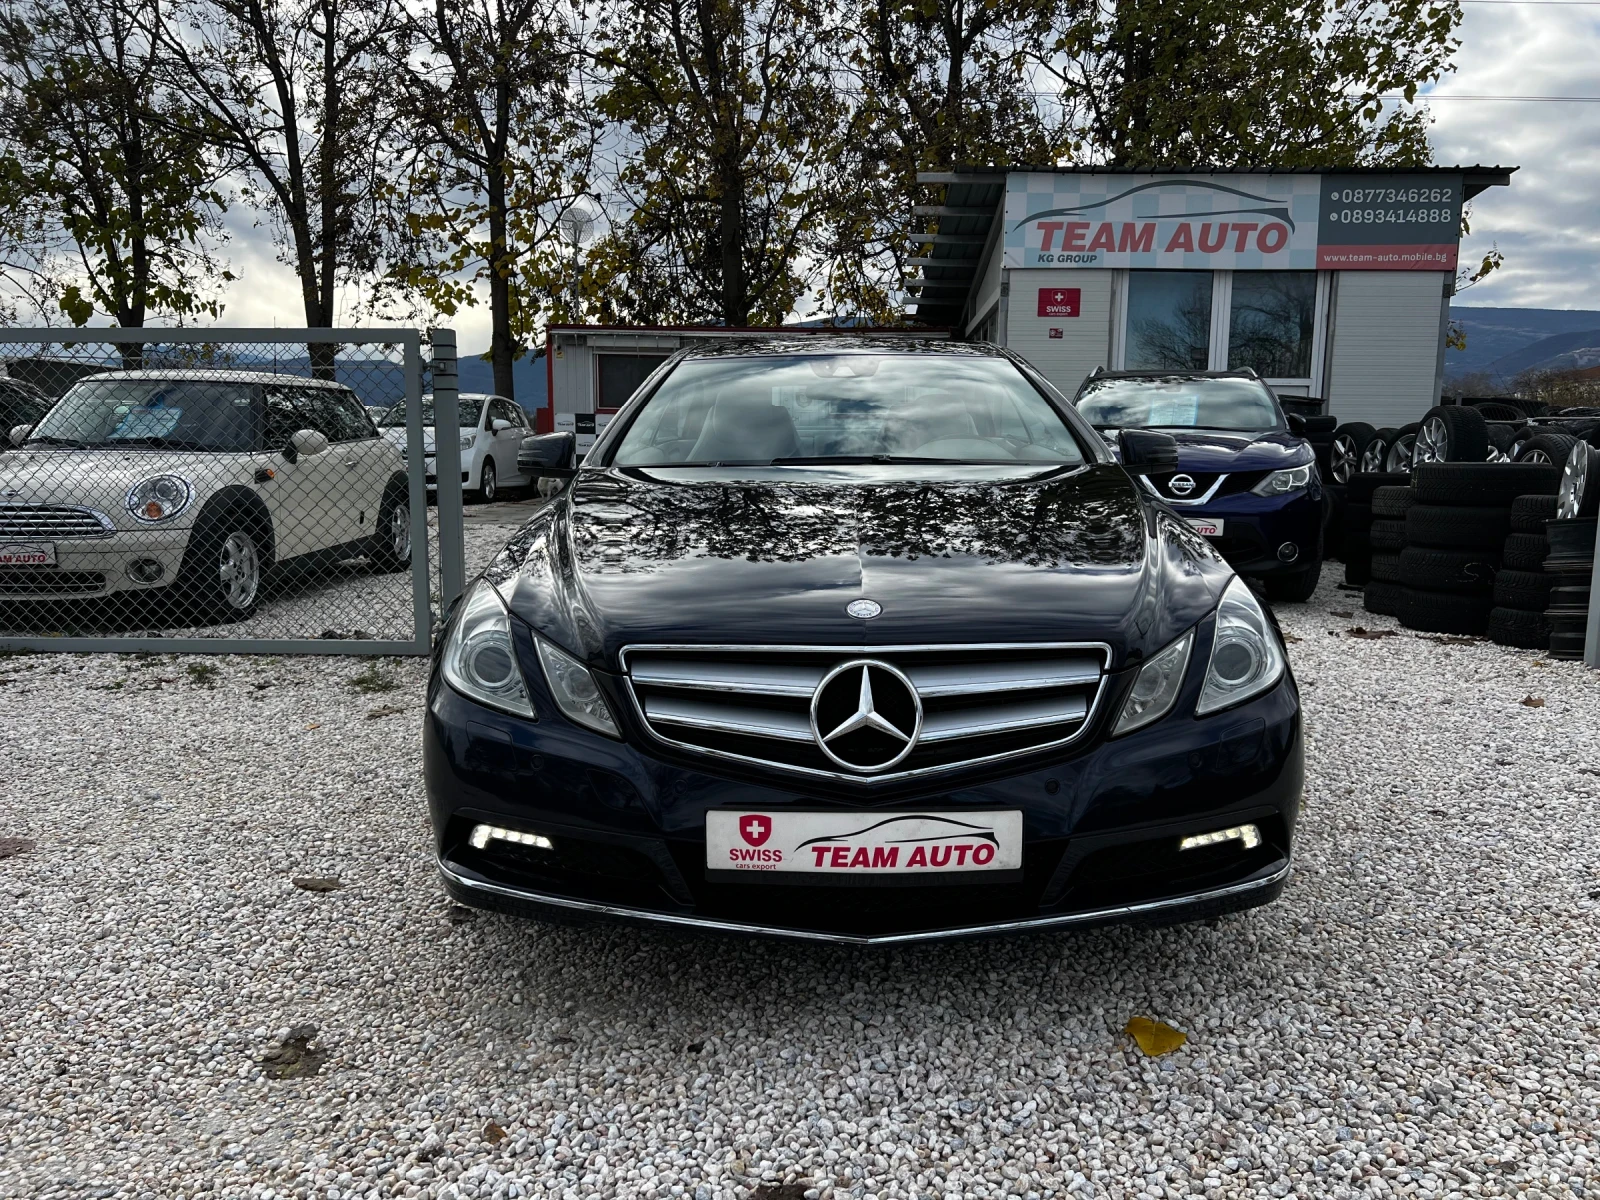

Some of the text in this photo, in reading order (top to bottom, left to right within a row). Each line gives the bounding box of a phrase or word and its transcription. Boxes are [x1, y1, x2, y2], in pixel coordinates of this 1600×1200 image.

[1342, 189, 1452, 203] 0877346262
[1341, 209, 1451, 223] 0893414888
[1036, 222, 1289, 253] TEAM AUTO
[1037, 254, 1098, 264] KG GROUP
[1324, 253, 1447, 262] www.team-auto.mobile.bg
[15, 554, 46, 563] AUTO
[729, 848, 783, 862] SWISS
[811, 844, 995, 868] TEAM AUTO
